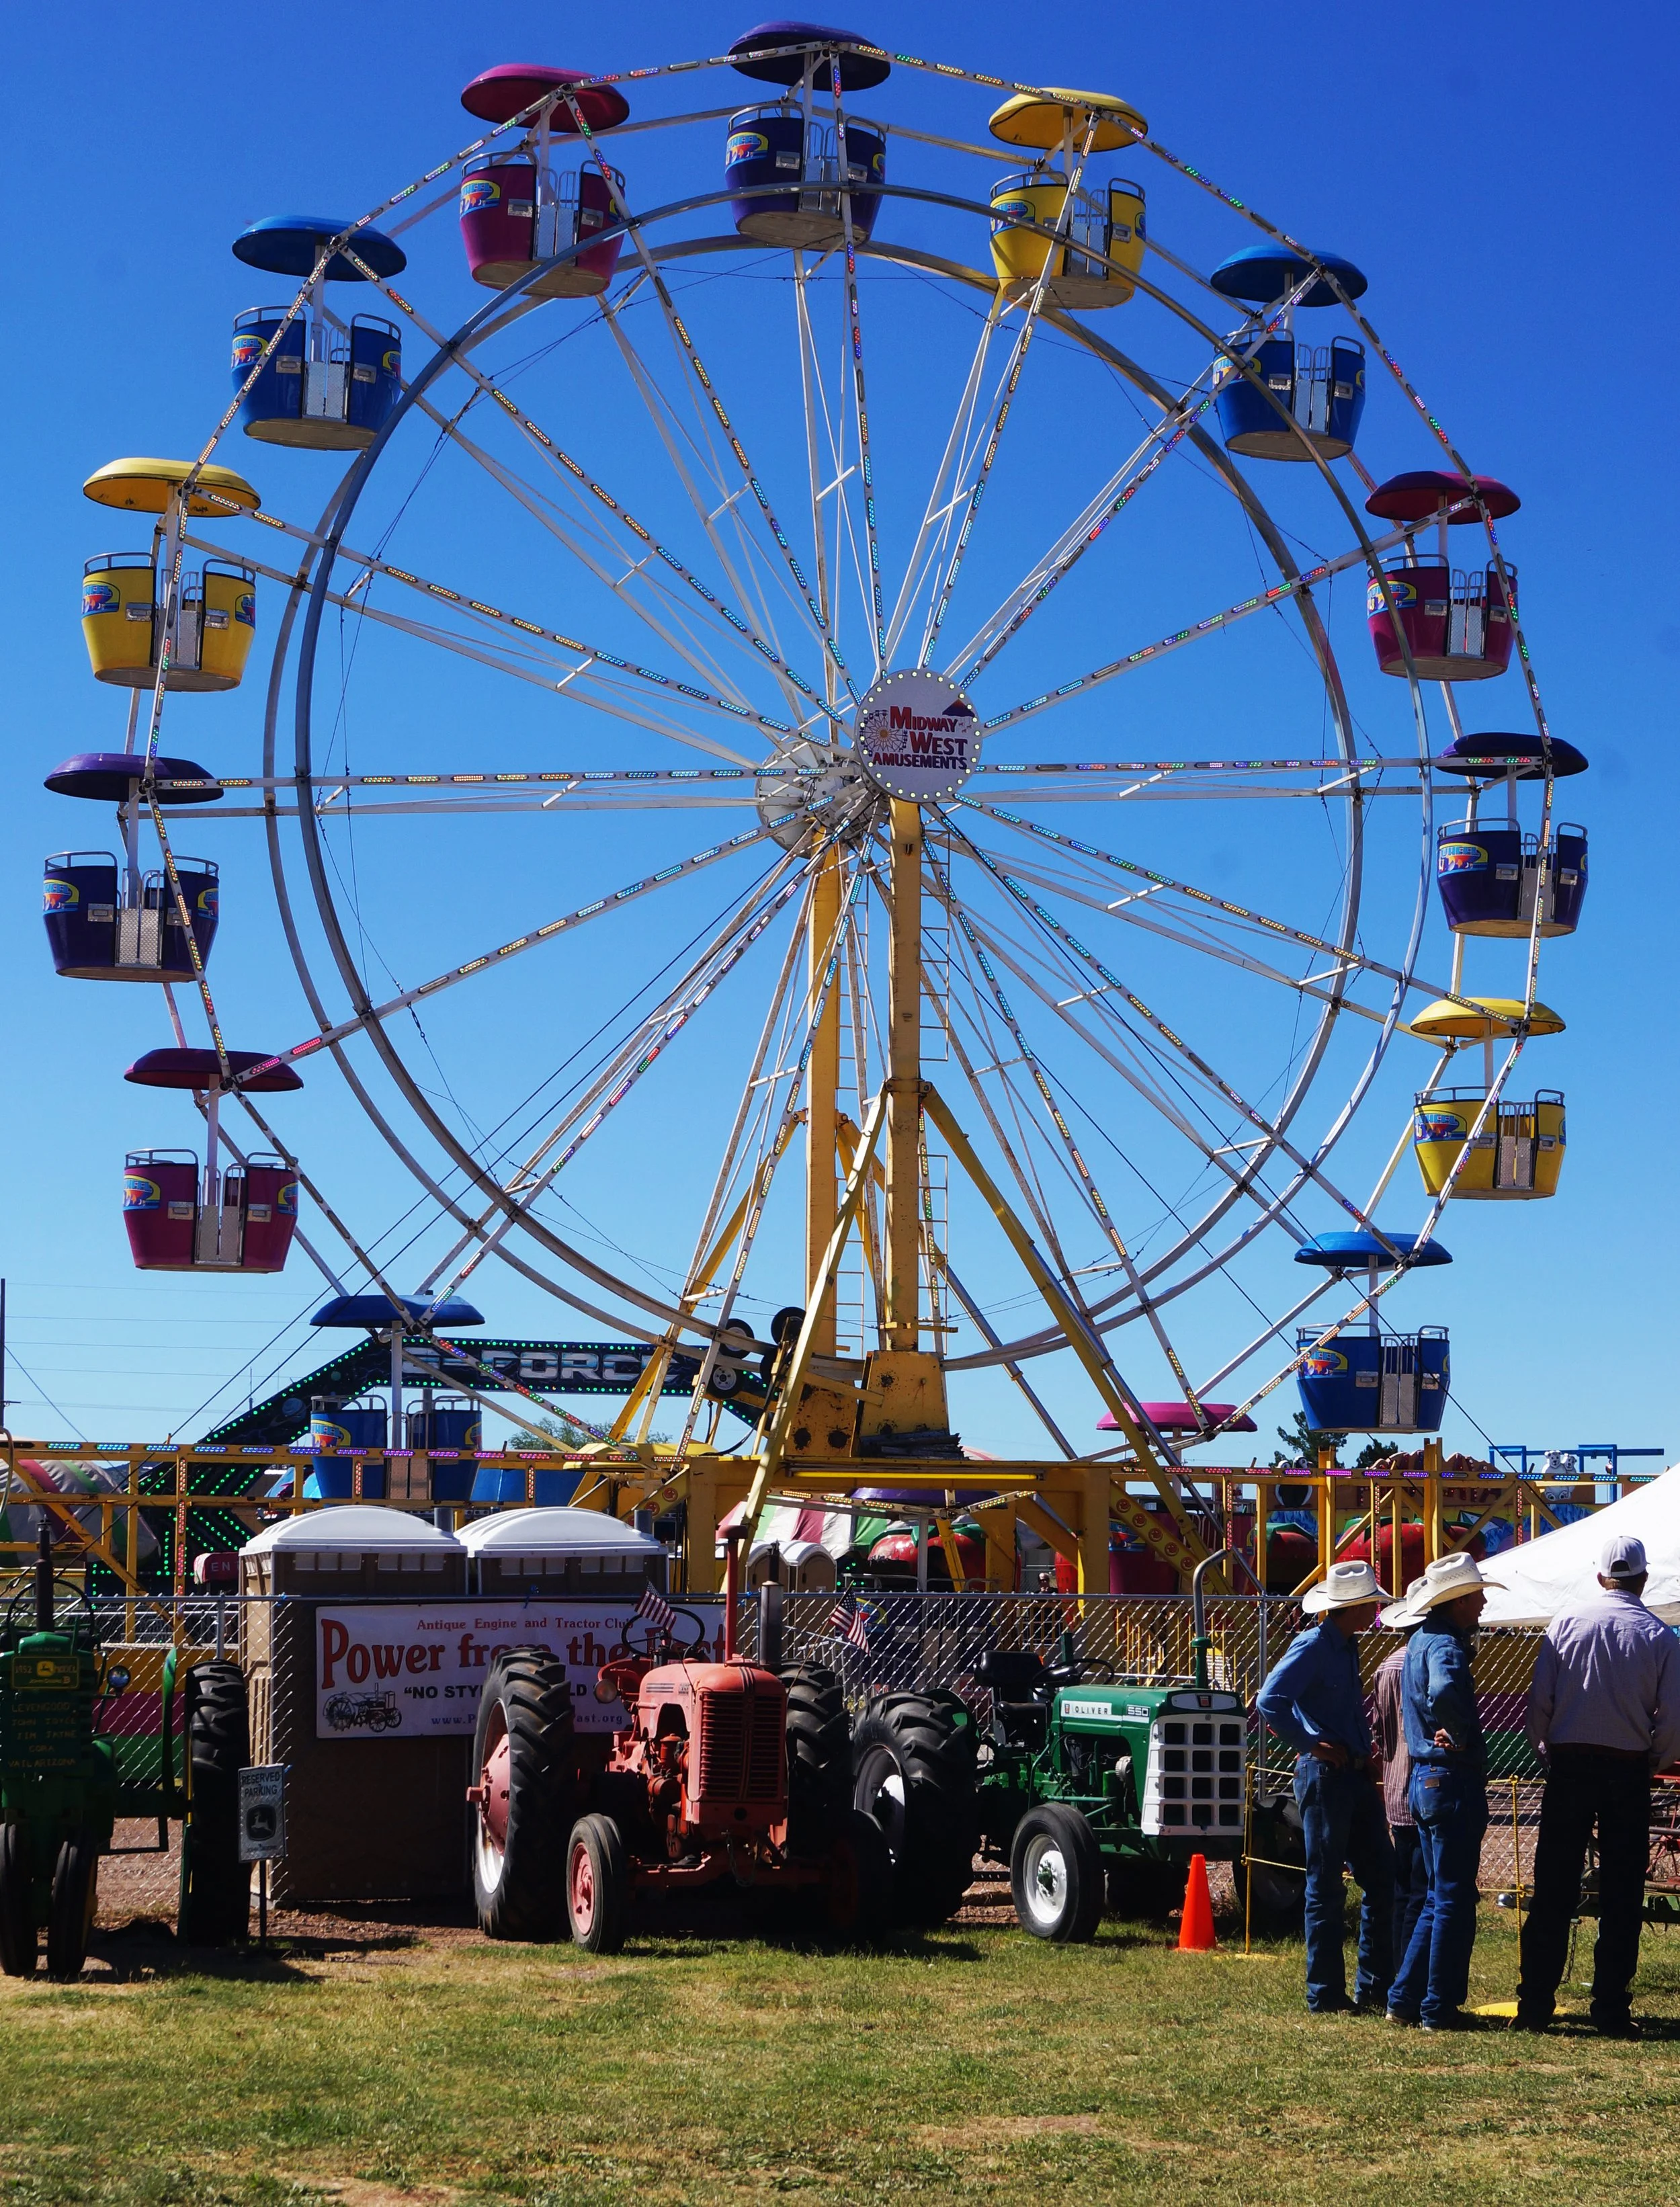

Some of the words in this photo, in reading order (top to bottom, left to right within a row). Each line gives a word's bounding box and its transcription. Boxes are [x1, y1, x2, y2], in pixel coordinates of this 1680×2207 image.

[873, 752, 968, 769] AMUSEMENTS
[417, 1618, 466, 1631] Antique
[474, 1618, 517, 1630] Engine
[524, 1617, 547, 1628] and
[555, 1617, 601, 1628] Tractor
[321, 1618, 446, 1690] Power
[566, 1632, 630, 1667] the
[15, 1665, 33, 1673] 1952
[1075, 1706, 1108, 1714] OLIVER
[242, 1771, 281, 1785] RESERVED
[245, 1784, 278, 1797] PARKING
